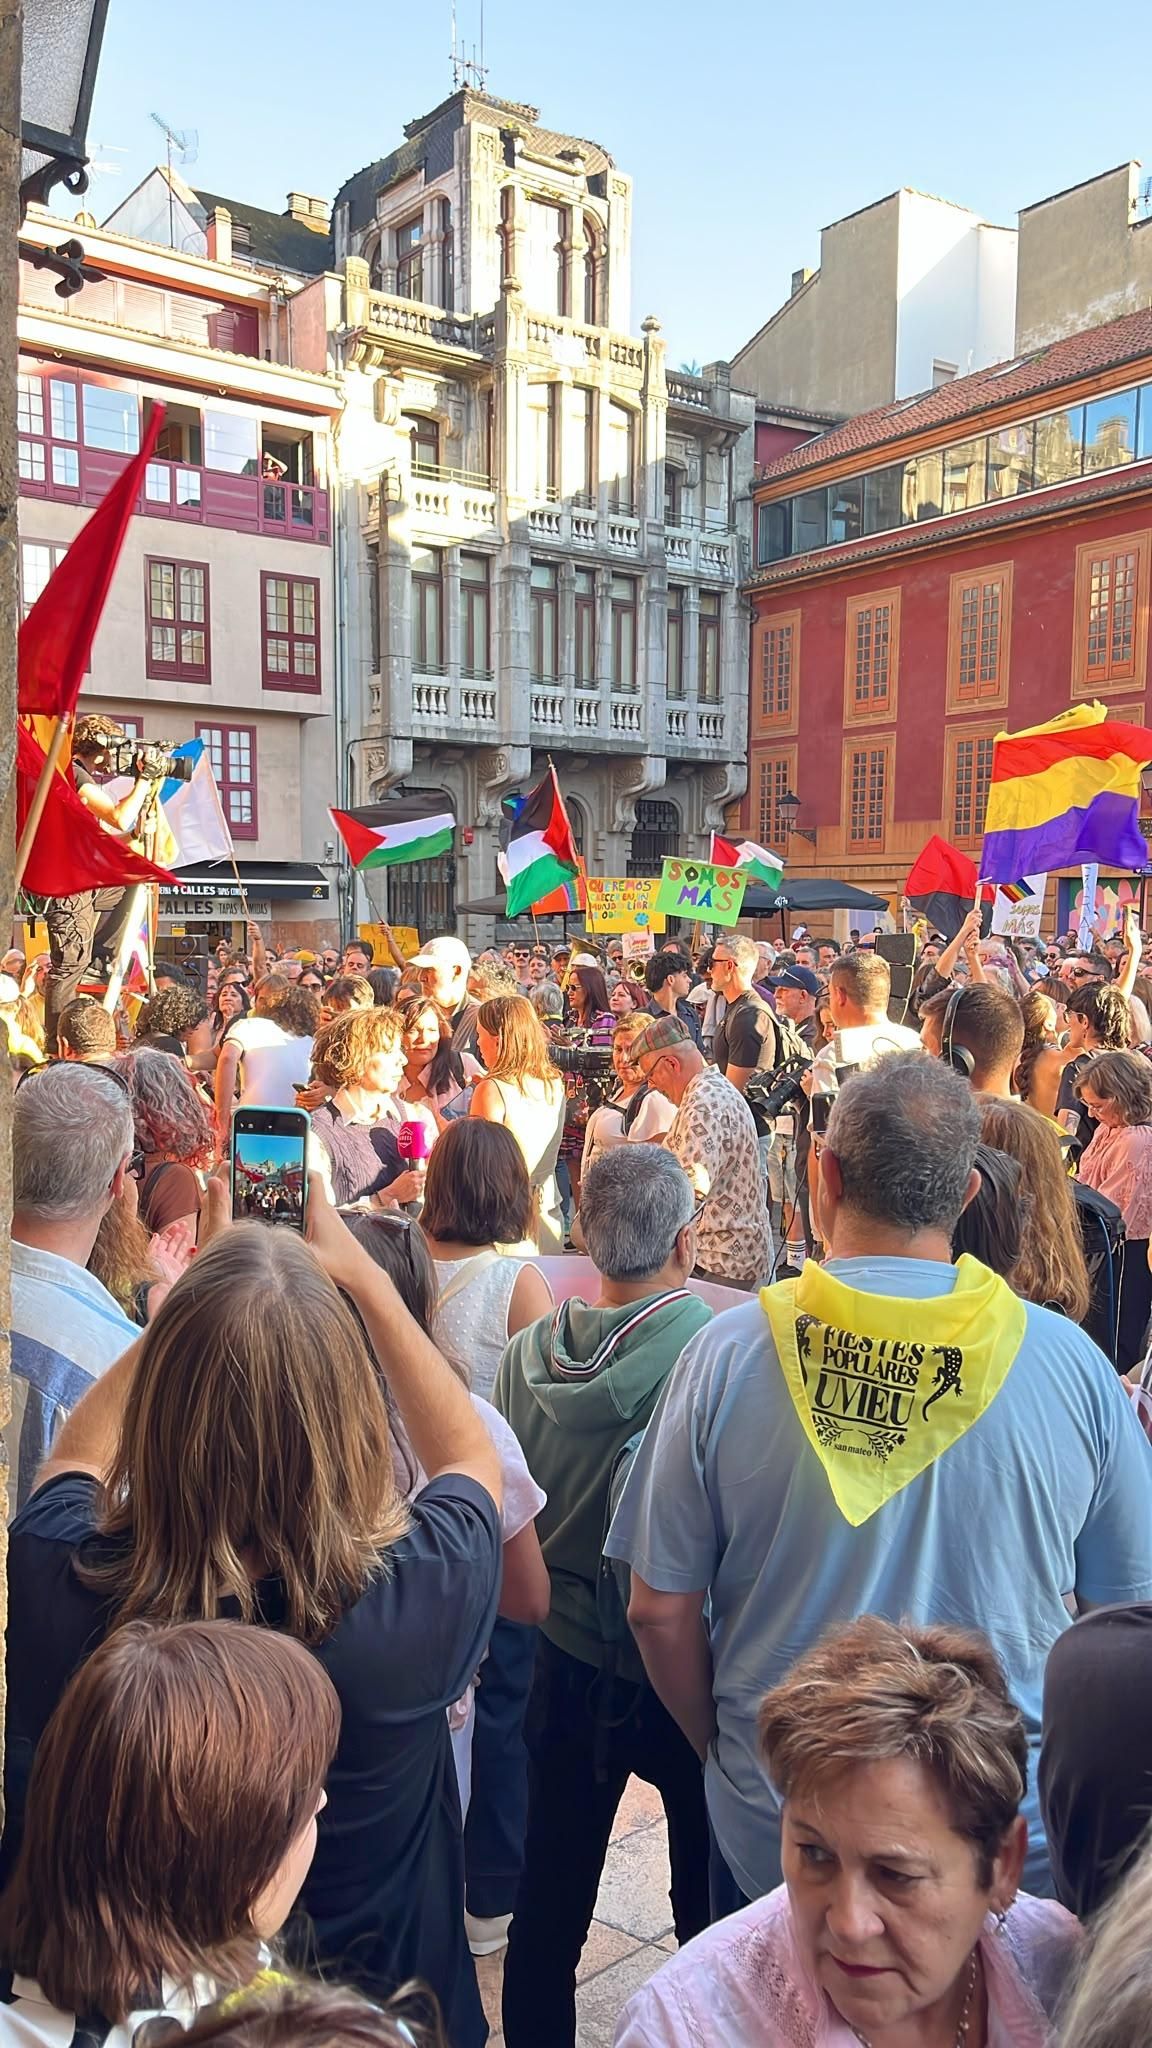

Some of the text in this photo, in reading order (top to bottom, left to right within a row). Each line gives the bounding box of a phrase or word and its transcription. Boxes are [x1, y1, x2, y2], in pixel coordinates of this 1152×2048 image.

[588, 880, 652, 893] QUEREMOS
[668, 861, 743, 889] SOMOS
[173, 886, 179, 895] 4
[181, 885, 216, 896] CALLES
[677, 883, 733, 912] MÁS
[218, 902, 238, 915] TAPAS
[1001, 916, 1035, 936] MÁS
[824, 1325, 926, 1366] FIESTES
[822, 1346, 920, 1386] POPULARES
